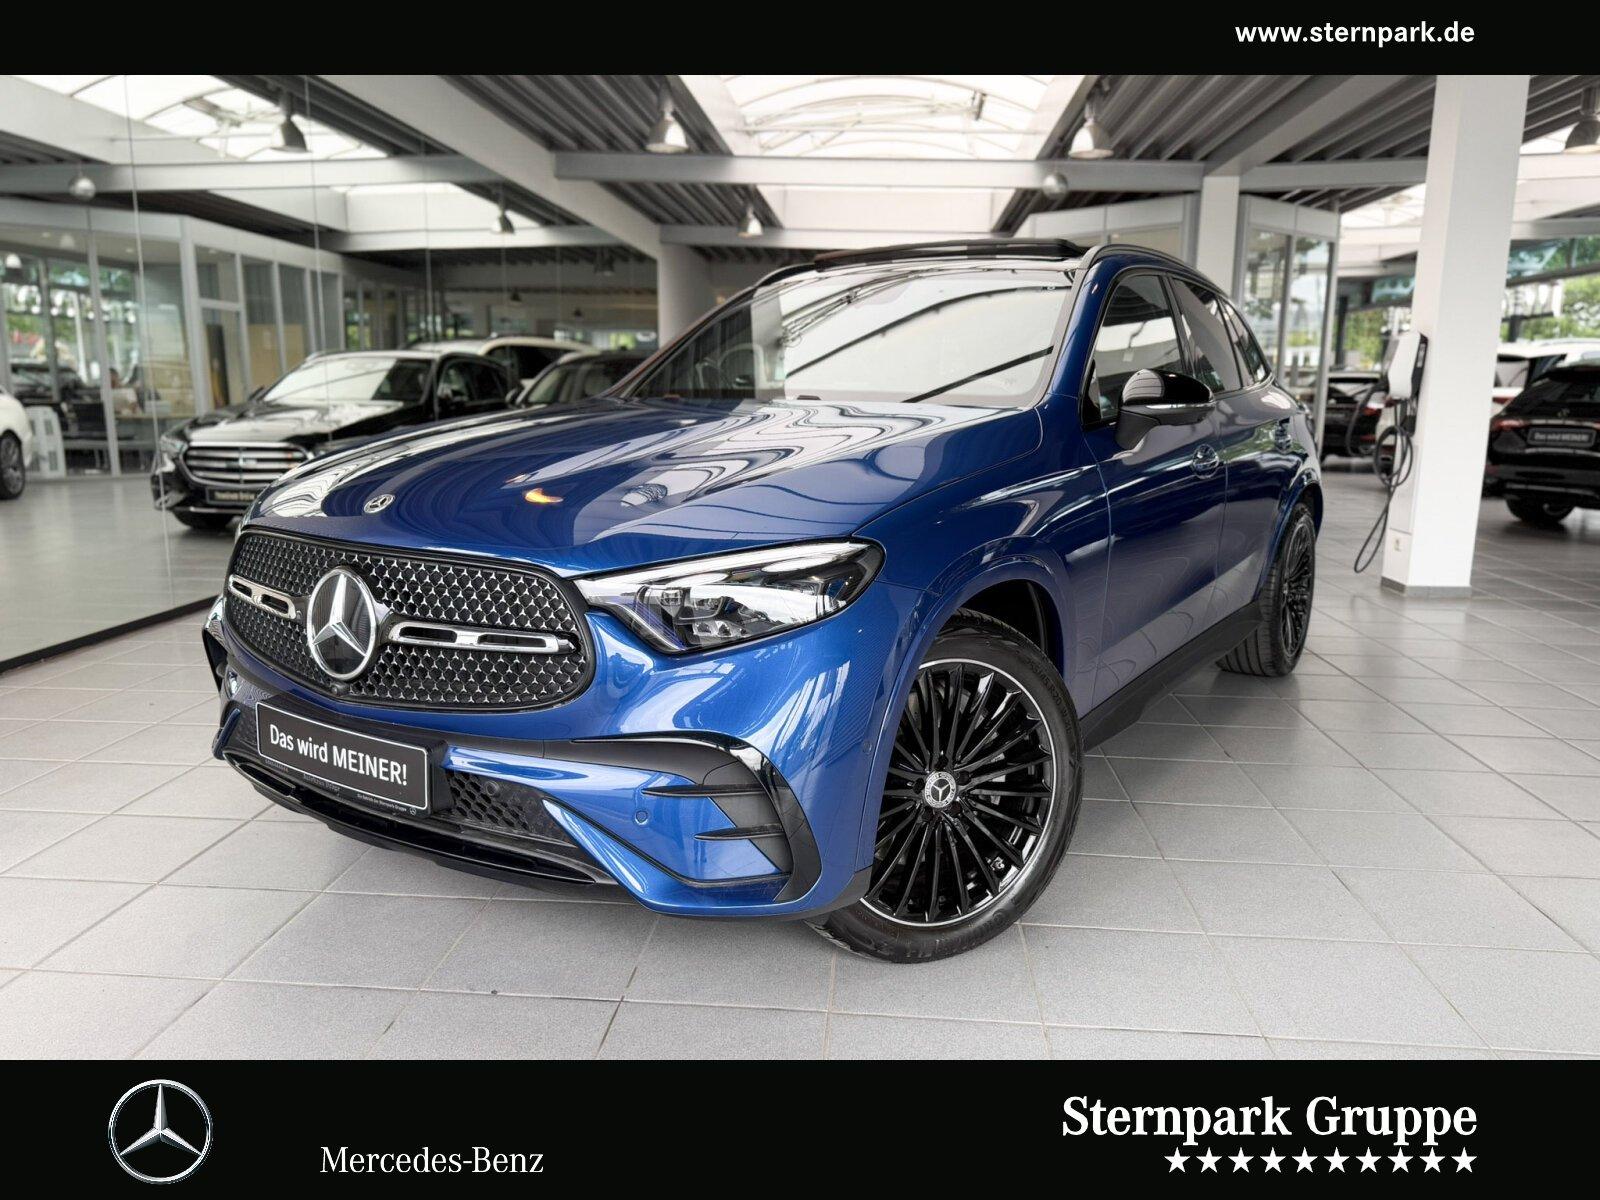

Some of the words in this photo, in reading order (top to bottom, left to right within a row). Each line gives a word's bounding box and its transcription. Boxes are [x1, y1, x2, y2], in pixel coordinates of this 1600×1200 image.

[269, 723, 295, 751] Das
[296, 736, 328, 764] wird
[332, 744, 408, 787] MEINER!
